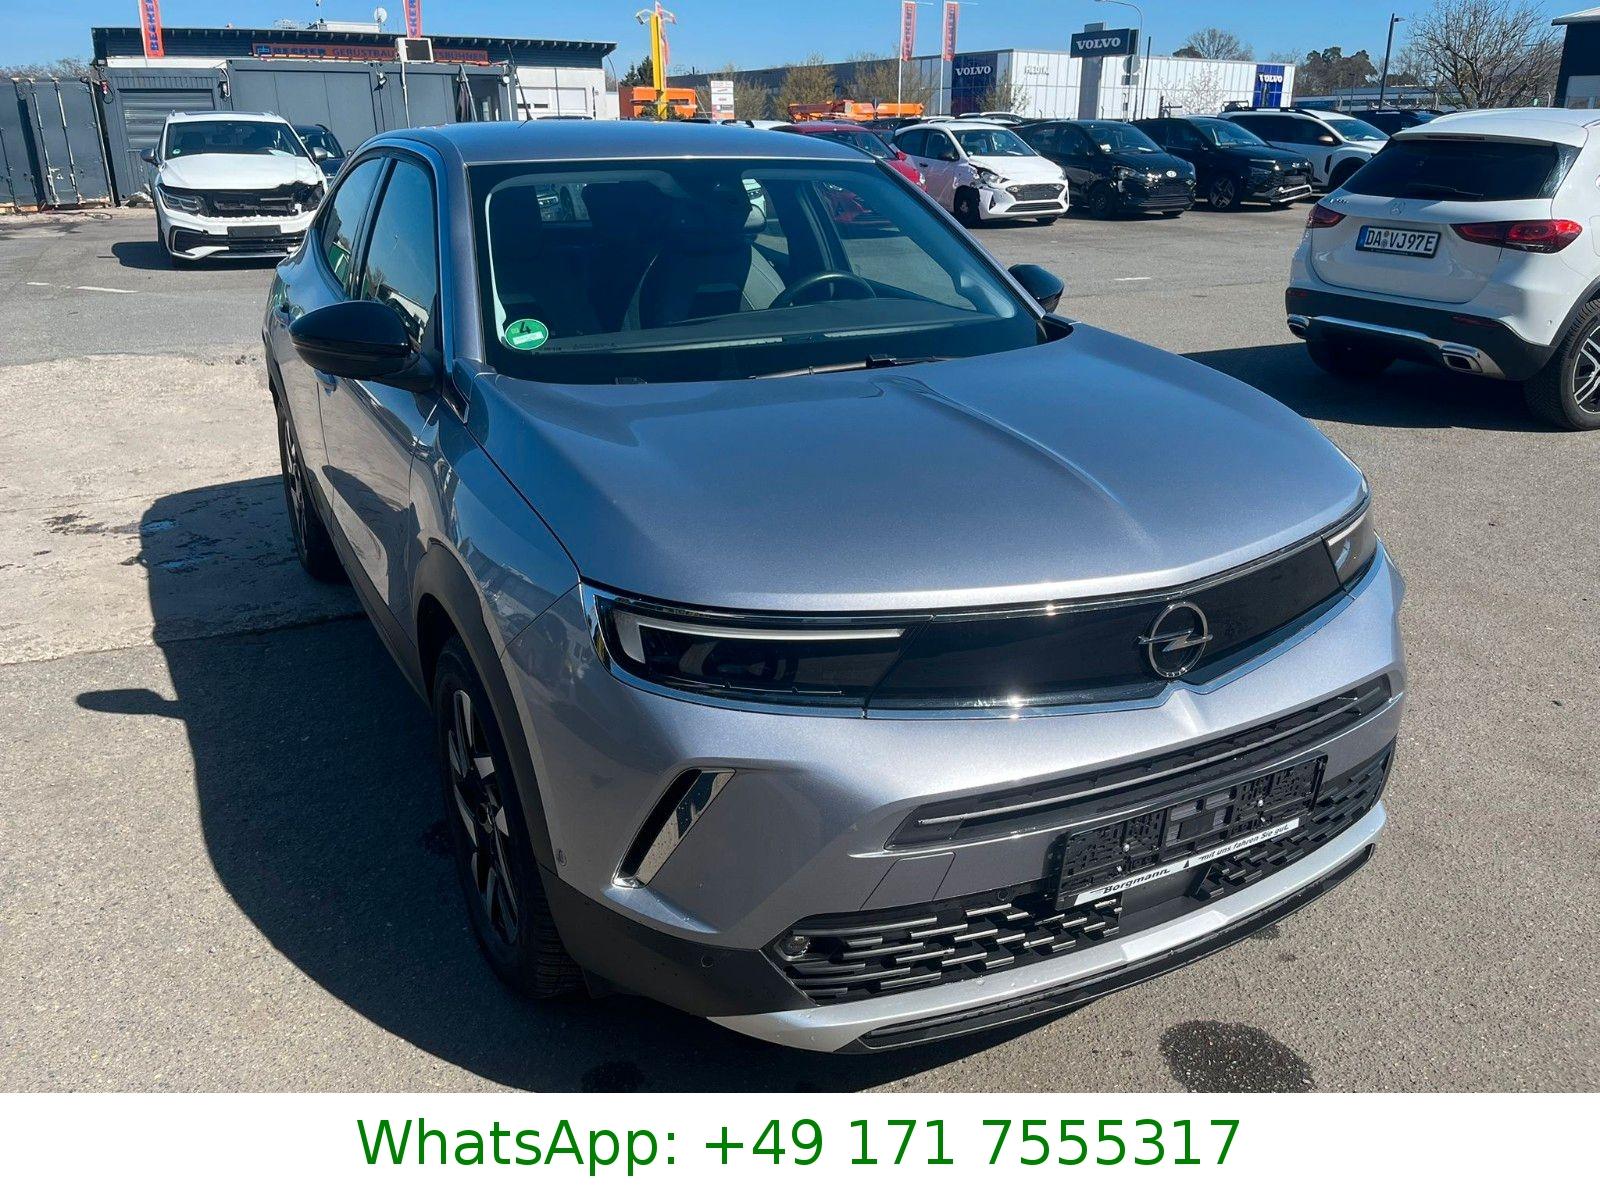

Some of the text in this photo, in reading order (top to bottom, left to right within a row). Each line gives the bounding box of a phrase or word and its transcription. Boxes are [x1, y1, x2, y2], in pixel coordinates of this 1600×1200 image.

[1075, 37, 1121, 50] VOLVO
[955, 65, 992, 76] VOLVO
[1258, 73, 1283, 83] VOLVO
[1365, 230, 1436, 252] DA VJ97E
[519, 321, 531, 333] 4
